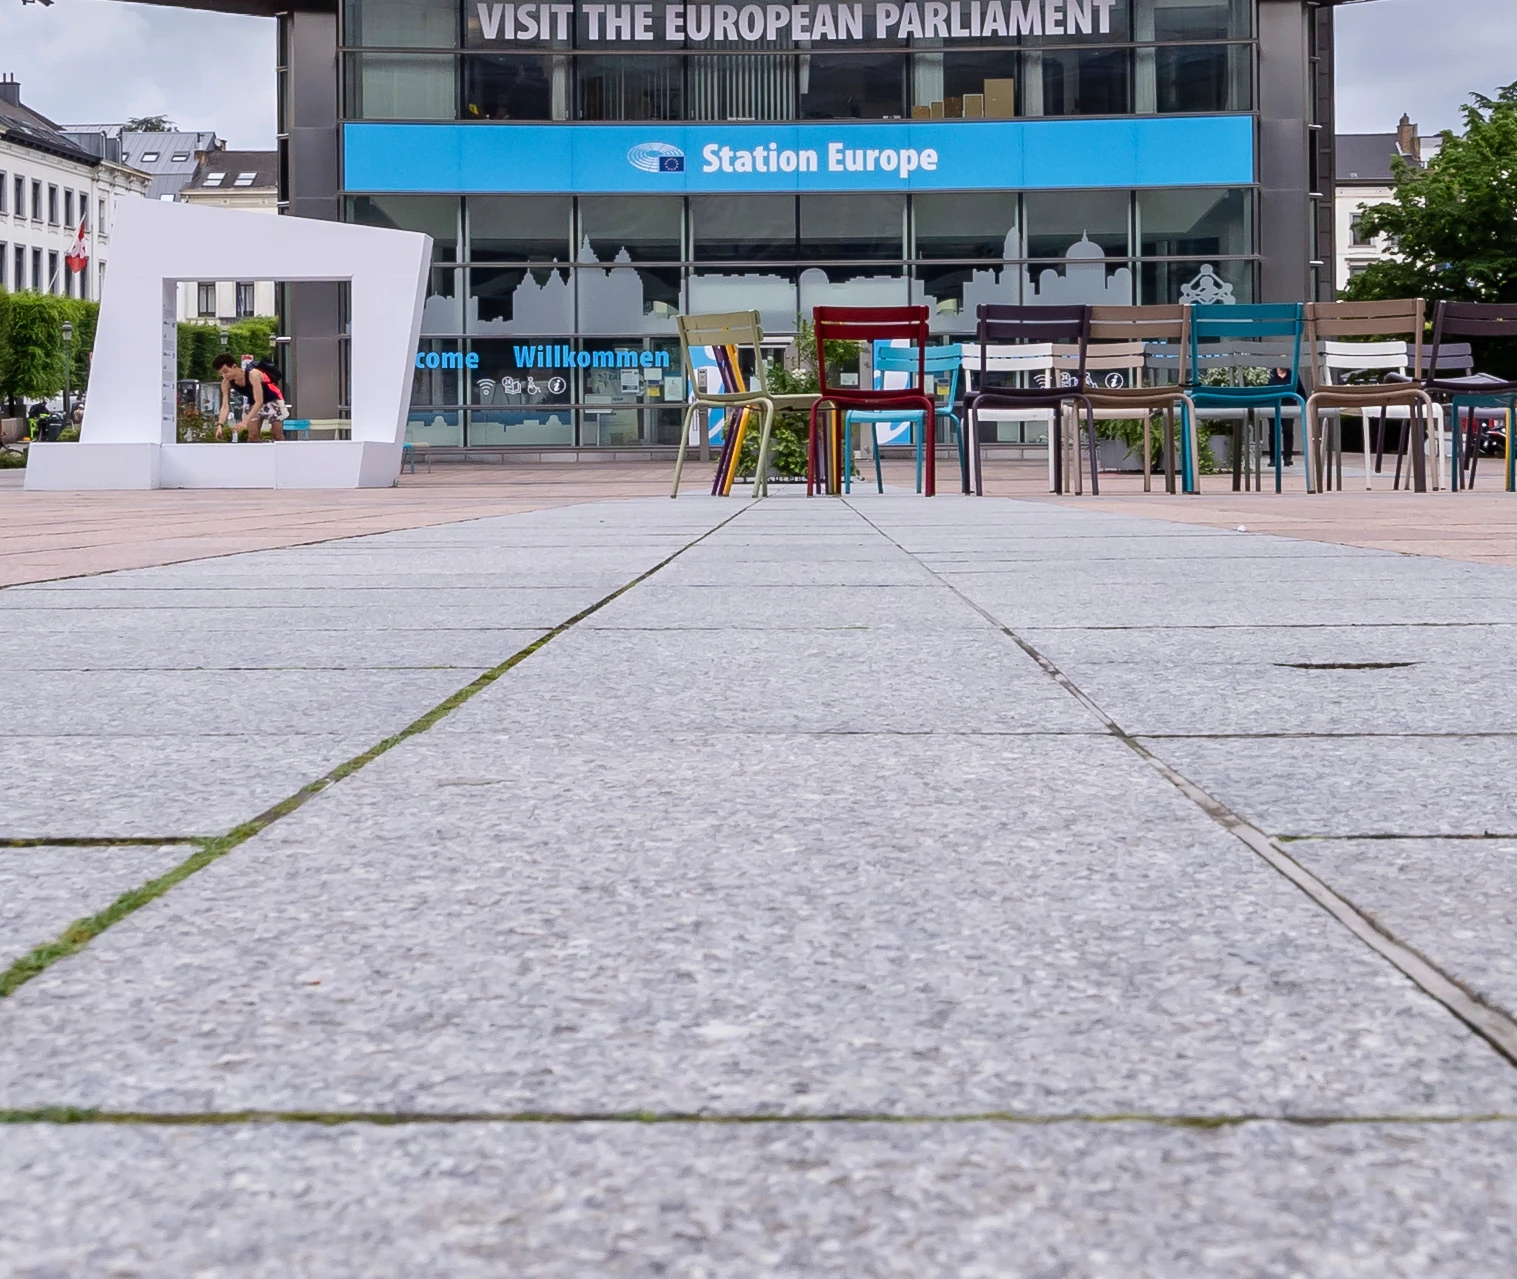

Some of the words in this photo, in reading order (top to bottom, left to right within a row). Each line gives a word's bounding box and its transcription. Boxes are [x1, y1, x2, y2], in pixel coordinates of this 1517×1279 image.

[477, 2, 573, 40] VISIT
[582, 4, 654, 41] THE
[665, 3, 862, 41] EUROPEAN
[702, 142, 817, 173] Station
[828, 142, 938, 179] Europe
[415, 351, 479, 369] come
[513, 344, 670, 368] Willkommen
